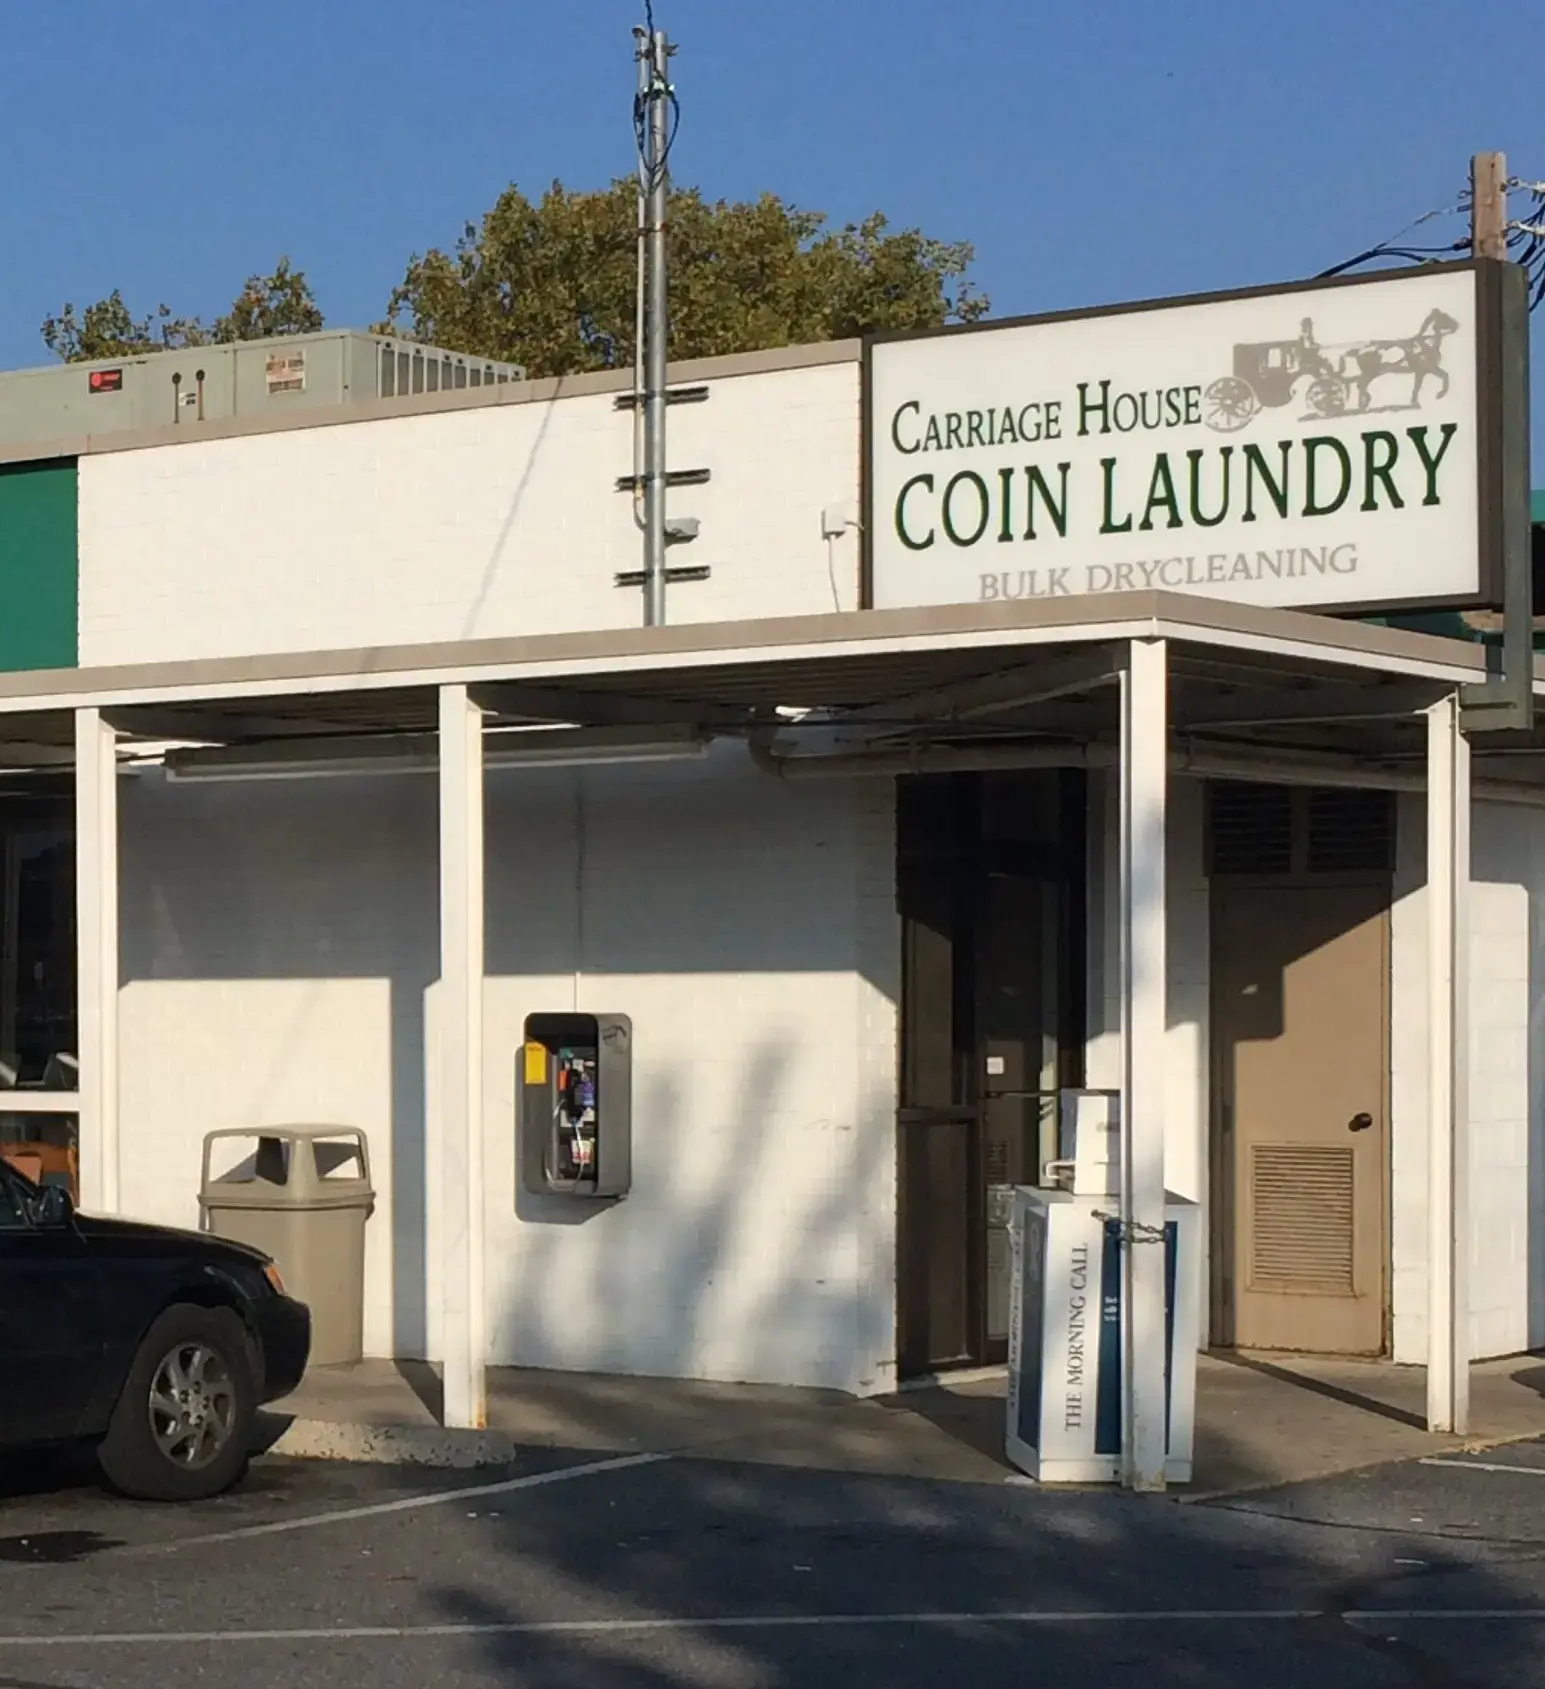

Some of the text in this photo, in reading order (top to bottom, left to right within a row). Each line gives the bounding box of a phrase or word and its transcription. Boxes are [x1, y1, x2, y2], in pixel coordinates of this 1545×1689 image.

[894, 423, 1457, 551] COIN LAUNDRY
[978, 543, 1358, 602] BULK DRYCLEANING
[1065, 1242, 1089, 1431] THE MORNING CALL
